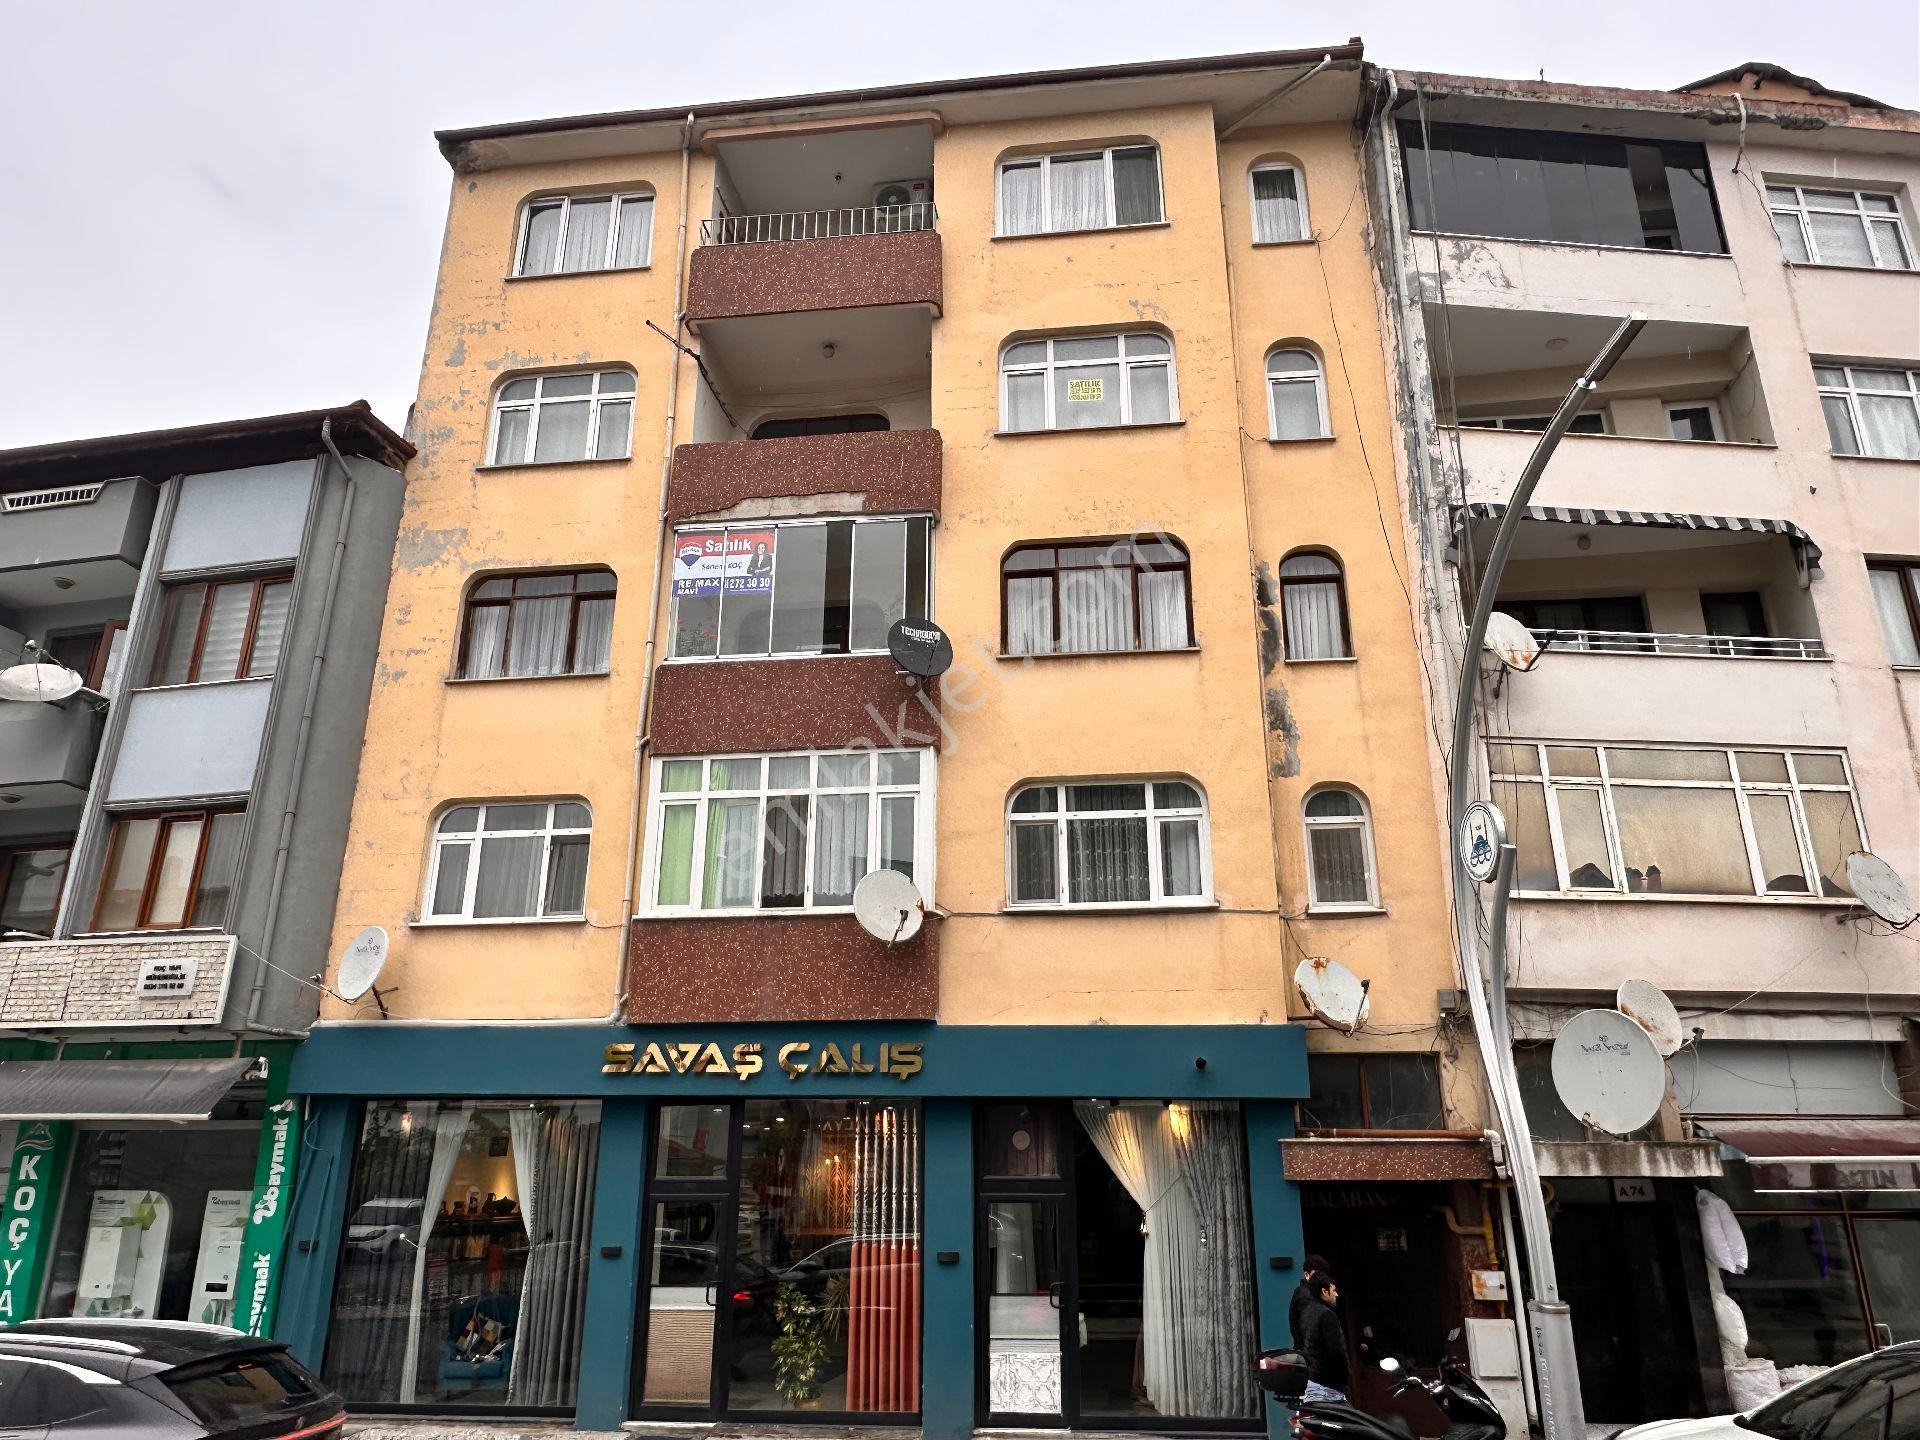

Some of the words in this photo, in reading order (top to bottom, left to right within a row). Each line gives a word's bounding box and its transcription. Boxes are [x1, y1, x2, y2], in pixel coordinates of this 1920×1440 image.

[746, 577, 758, 588] 30
[759, 577, 771, 588] 30
[601, 1041, 764, 1081] SAVAŞ
[778, 1041, 924, 1080] ÇALIŞ
[8, 1154, 42, 1251] KOÇ
